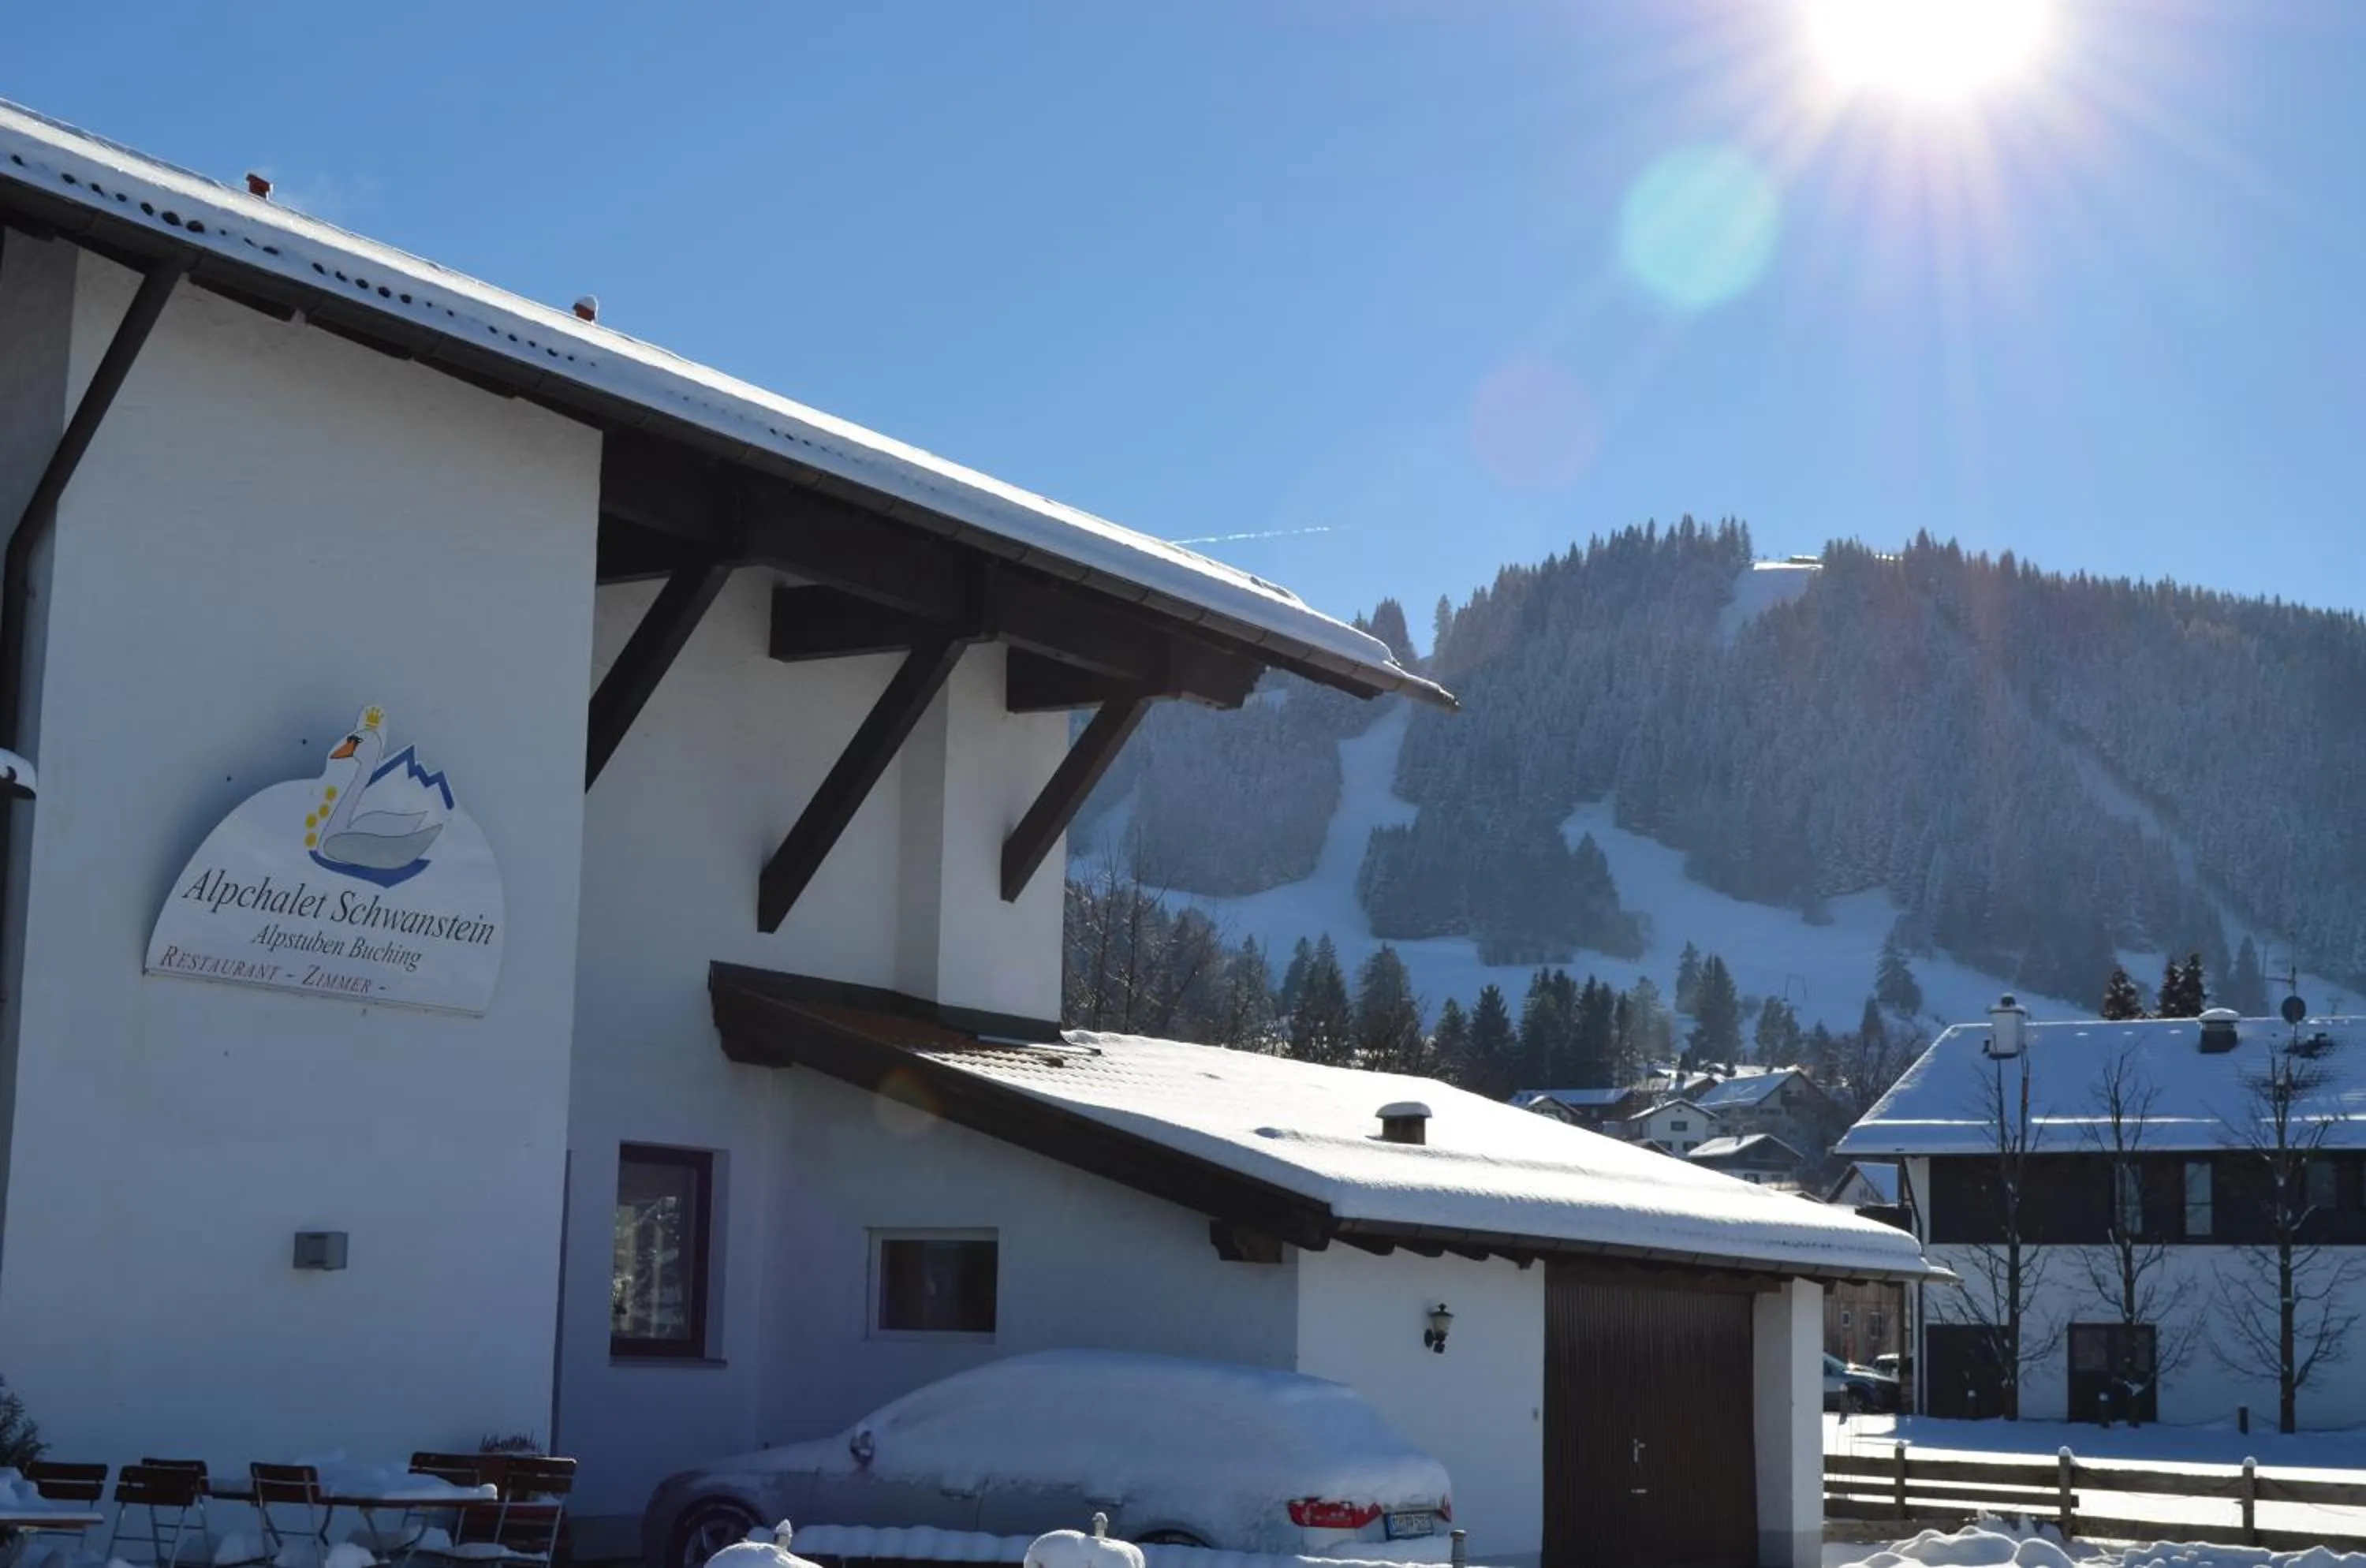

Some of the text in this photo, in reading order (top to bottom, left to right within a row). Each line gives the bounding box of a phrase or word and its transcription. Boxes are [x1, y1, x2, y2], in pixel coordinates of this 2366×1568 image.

[181, 868, 495, 946] Alpchalet Schwanstein
[160, 945, 282, 981] RESTAURANT
[302, 963, 372, 994] ZIMMER
[251, 924, 423, 973] Alpstuben Buching
